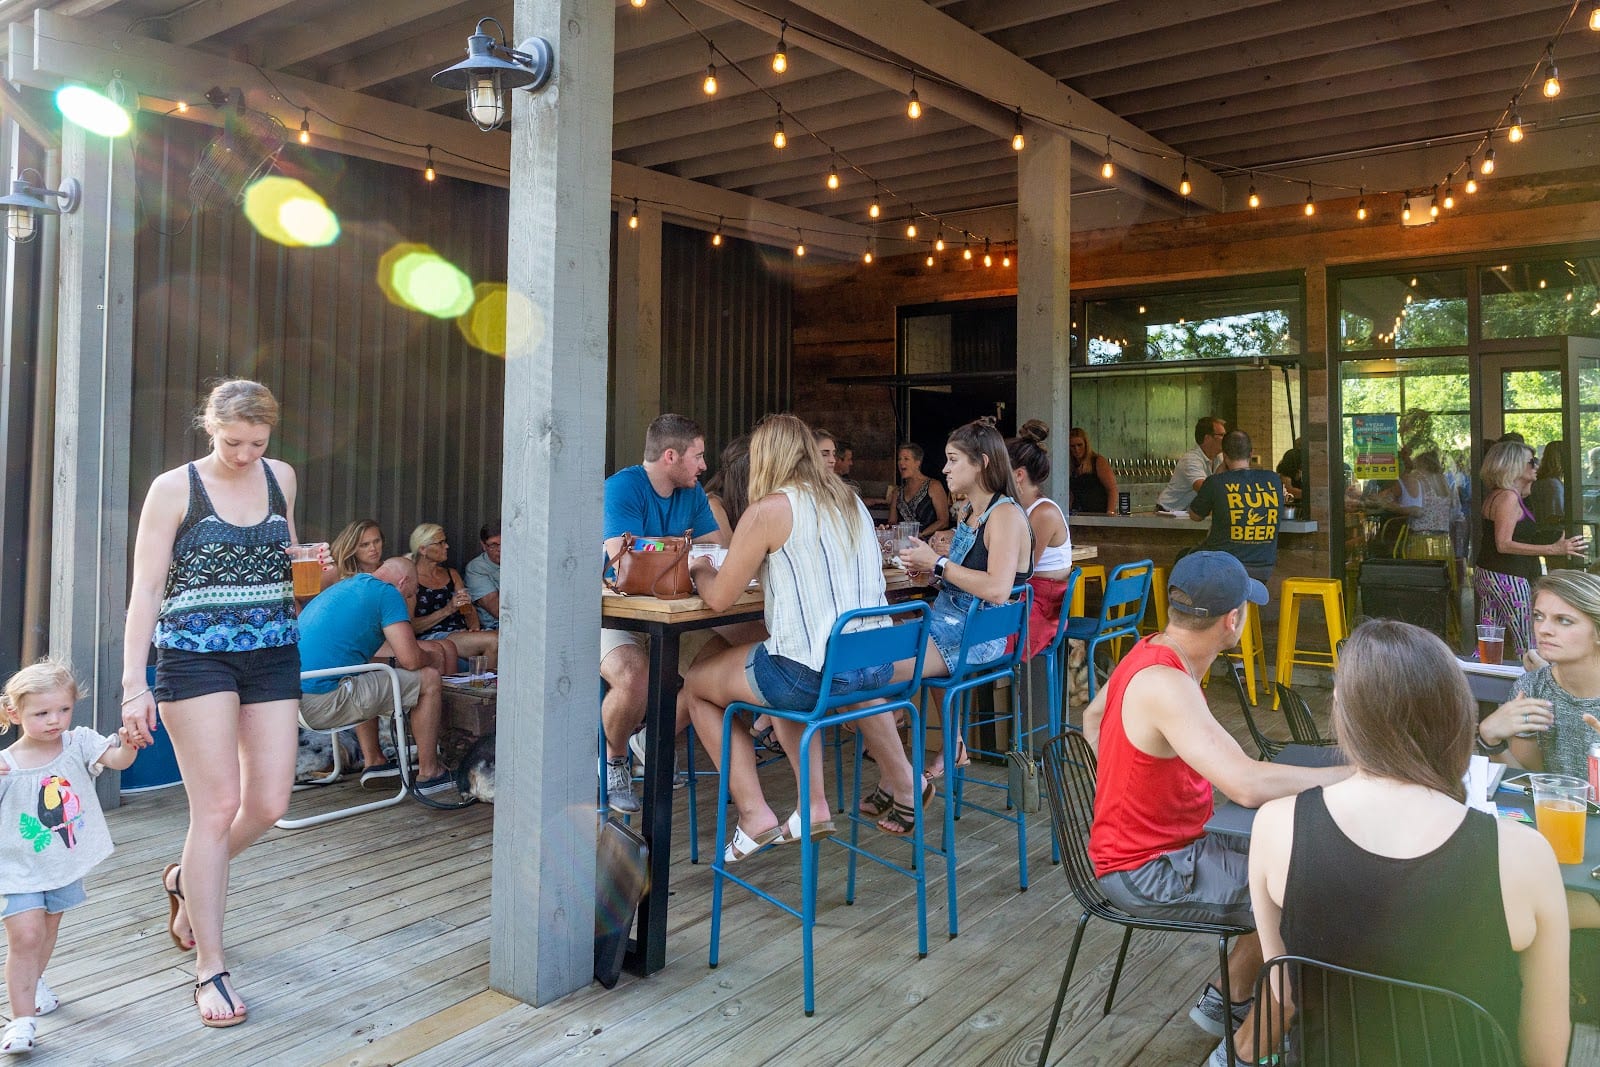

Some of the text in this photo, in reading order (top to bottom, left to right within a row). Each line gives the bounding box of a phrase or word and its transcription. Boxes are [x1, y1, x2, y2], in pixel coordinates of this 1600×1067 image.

[1225, 482, 1276, 492] WILL
[1228, 492, 1279, 508] RUN
[1231, 526, 1275, 540] BEER
